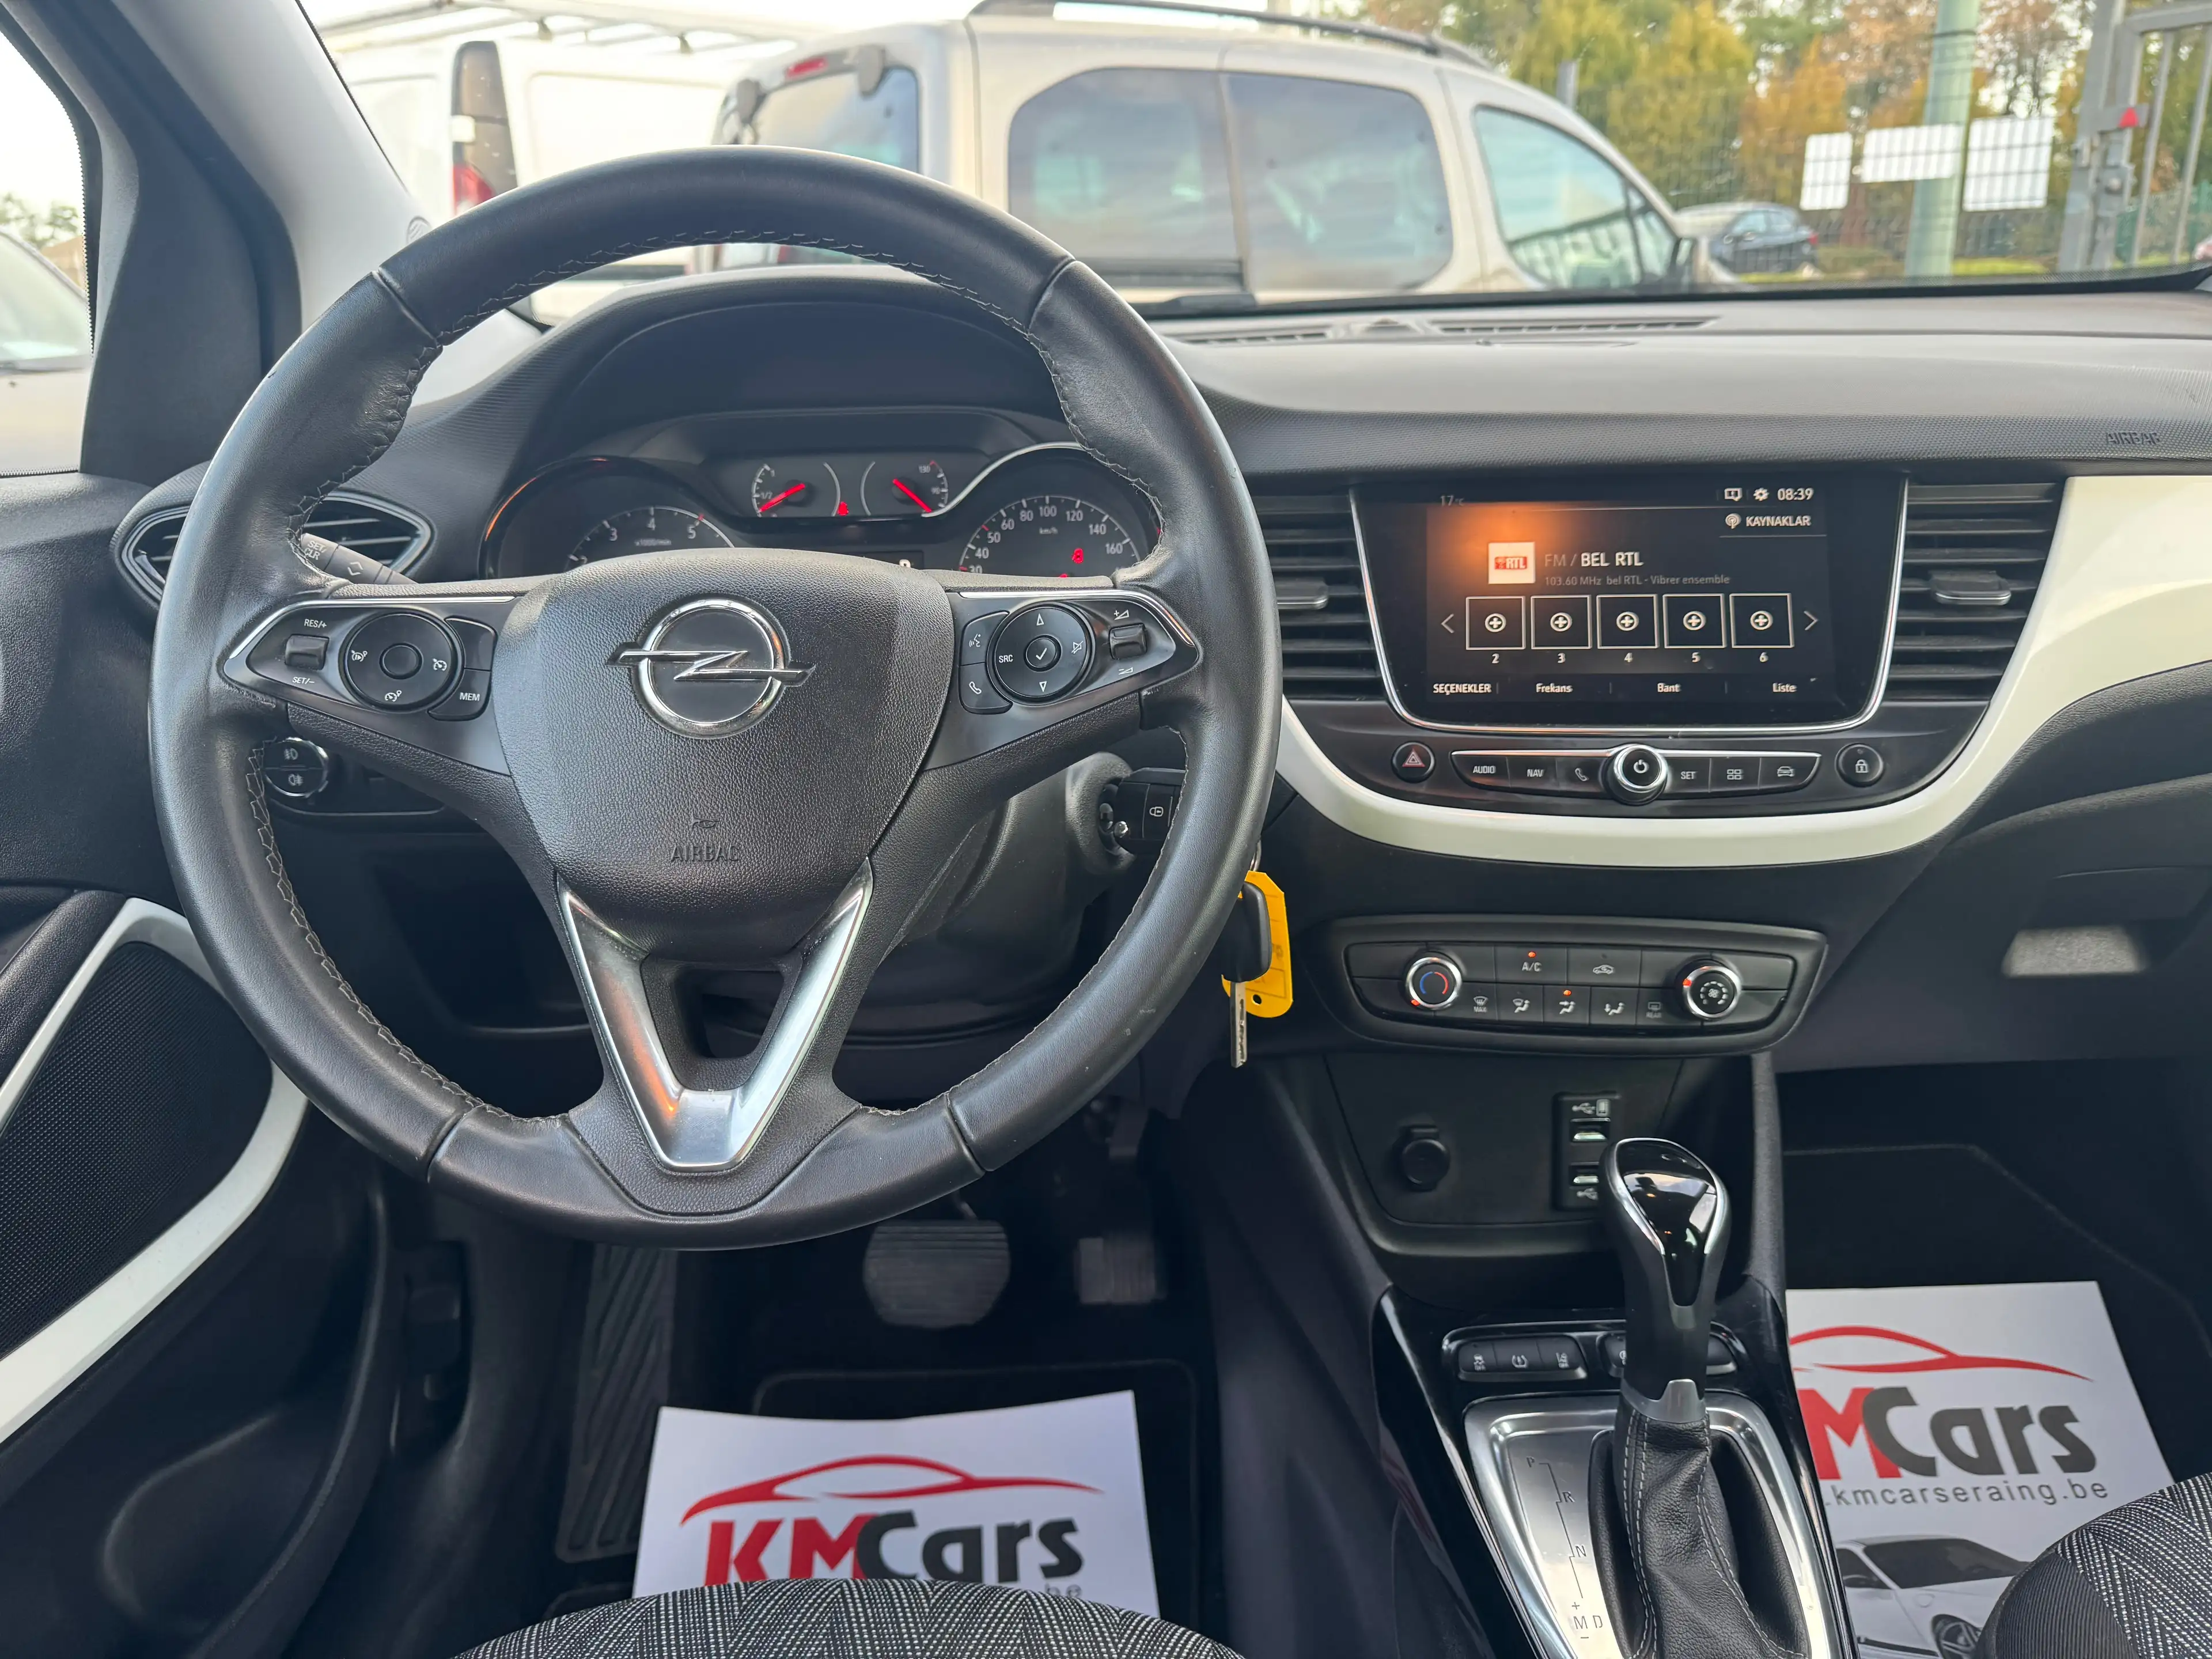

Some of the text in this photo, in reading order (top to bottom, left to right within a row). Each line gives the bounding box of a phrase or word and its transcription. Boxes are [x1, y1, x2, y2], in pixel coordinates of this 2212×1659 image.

[2105, 432, 2161, 445] AIRBAG
[1777, 487, 1815, 501] 08:39
[1020, 509, 1034, 522] 80
[1039, 505, 1058, 517] 100
[1066, 510, 1084, 522] 120
[647, 518, 657, 531] 4
[1001, 518, 1016, 531] 60
[1746, 515, 1812, 527] KAYNAKLAR
[609, 527, 618, 541] 3
[687, 524, 697, 540] 5
[1089, 524, 1107, 536] 140
[987, 532, 1001, 544] 50
[308, 540, 327, 553] SET/
[1105, 543, 1123, 555] 160
[304, 548, 321, 560] CLR
[975, 547, 990, 560] 40
[1544, 554, 1567, 567] FM
[1581, 552, 1610, 567] BEL
[1615, 551, 1644, 566] RTL
[1506, 557, 1527, 569] RTL
[1544, 576, 1577, 586] 103.60
[1580, 576, 1602, 586] MHz
[1606, 575, 1622, 585] bel
[1624, 575, 1642, 585] RTL
[1650, 575, 1680, 585] Vibrer
[1682, 574, 1731, 585] ensemble
[304, 618, 327, 629] RES/+
[998, 654, 1013, 663] SRC
[1491, 653, 1499, 664] 2
[1558, 653, 1566, 663] 3
[1624, 652, 1634, 662] 4
[1692, 652, 1701, 662] 5
[1759, 652, 1769, 662] 6
[1433, 683, 1492, 695] SEÇENEKLER
[1536, 682, 1573, 693] Frekans
[1657, 682, 1681, 693] Bant
[1772, 682, 1798, 693] Liste
[459, 693, 480, 702] MEM
[1472, 766, 1497, 774] AUDIO
[1527, 769, 1544, 778] NAV
[1680, 771, 1696, 779] SET
[670, 846, 740, 863] AIRBAG
[1521, 961, 1542, 972] A/C
[1527, 1456, 1536, 1468] P
[1561, 1491, 1575, 1503] R
[703, 1510, 1084, 1587] KMCars
[1575, 1545, 1588, 1557] N
[1573, 1615, 1604, 1630] M D
